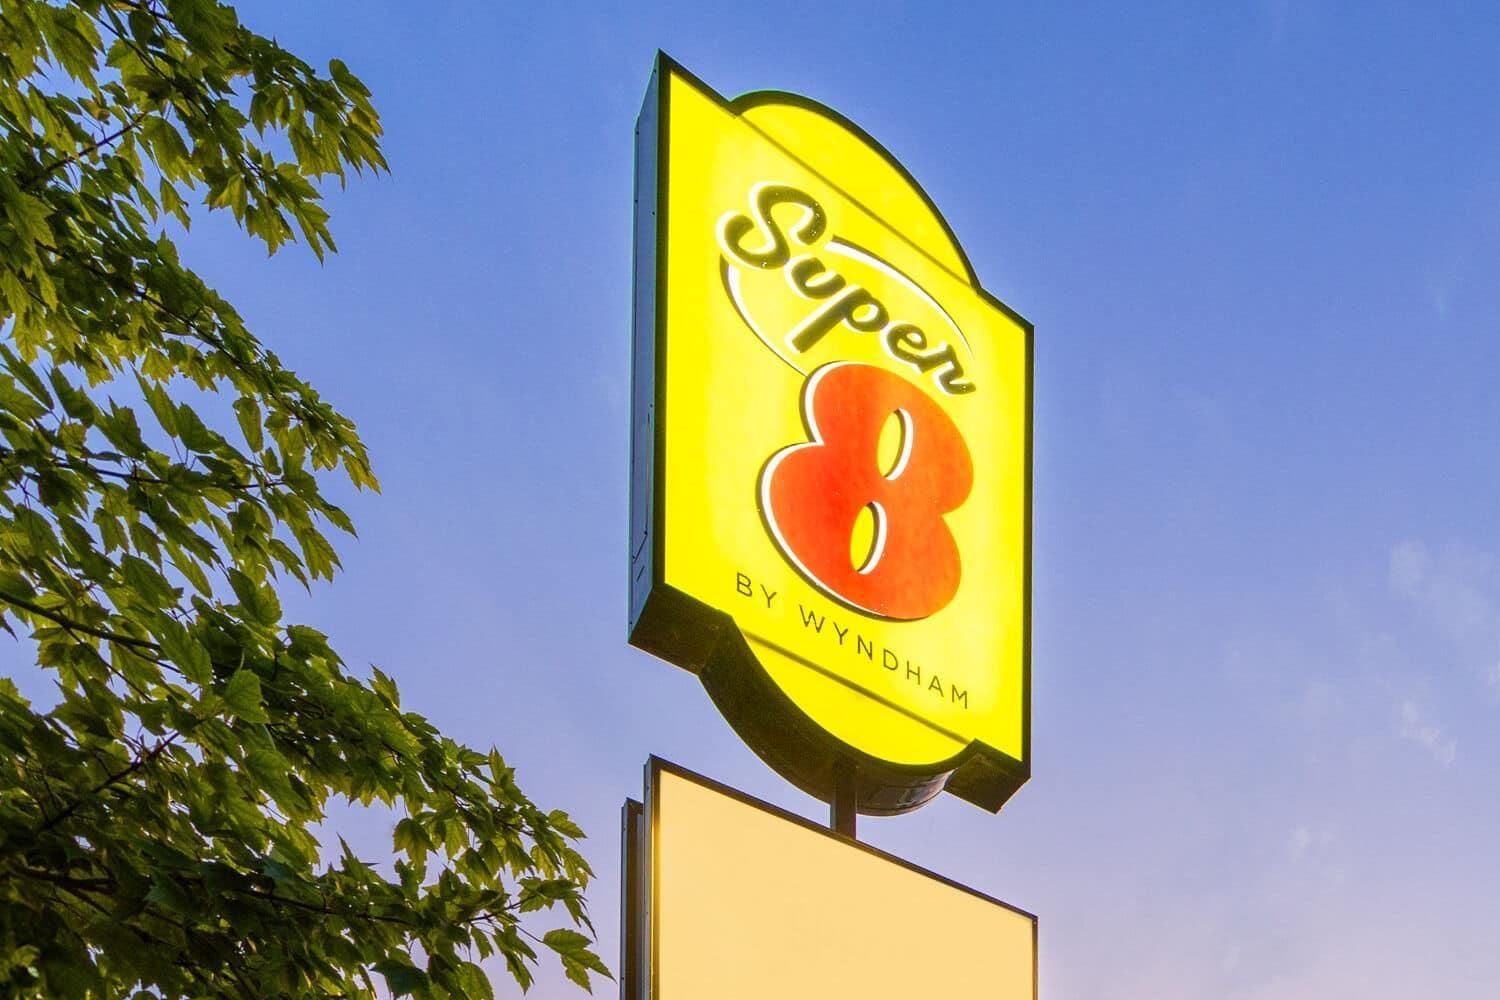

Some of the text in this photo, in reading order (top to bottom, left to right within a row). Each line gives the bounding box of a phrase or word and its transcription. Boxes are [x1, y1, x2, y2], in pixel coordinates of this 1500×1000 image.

[720, 185, 976, 396] Super
[756, 361, 974, 621] 8
[735, 572, 970, 710] BY WYNDHAM
